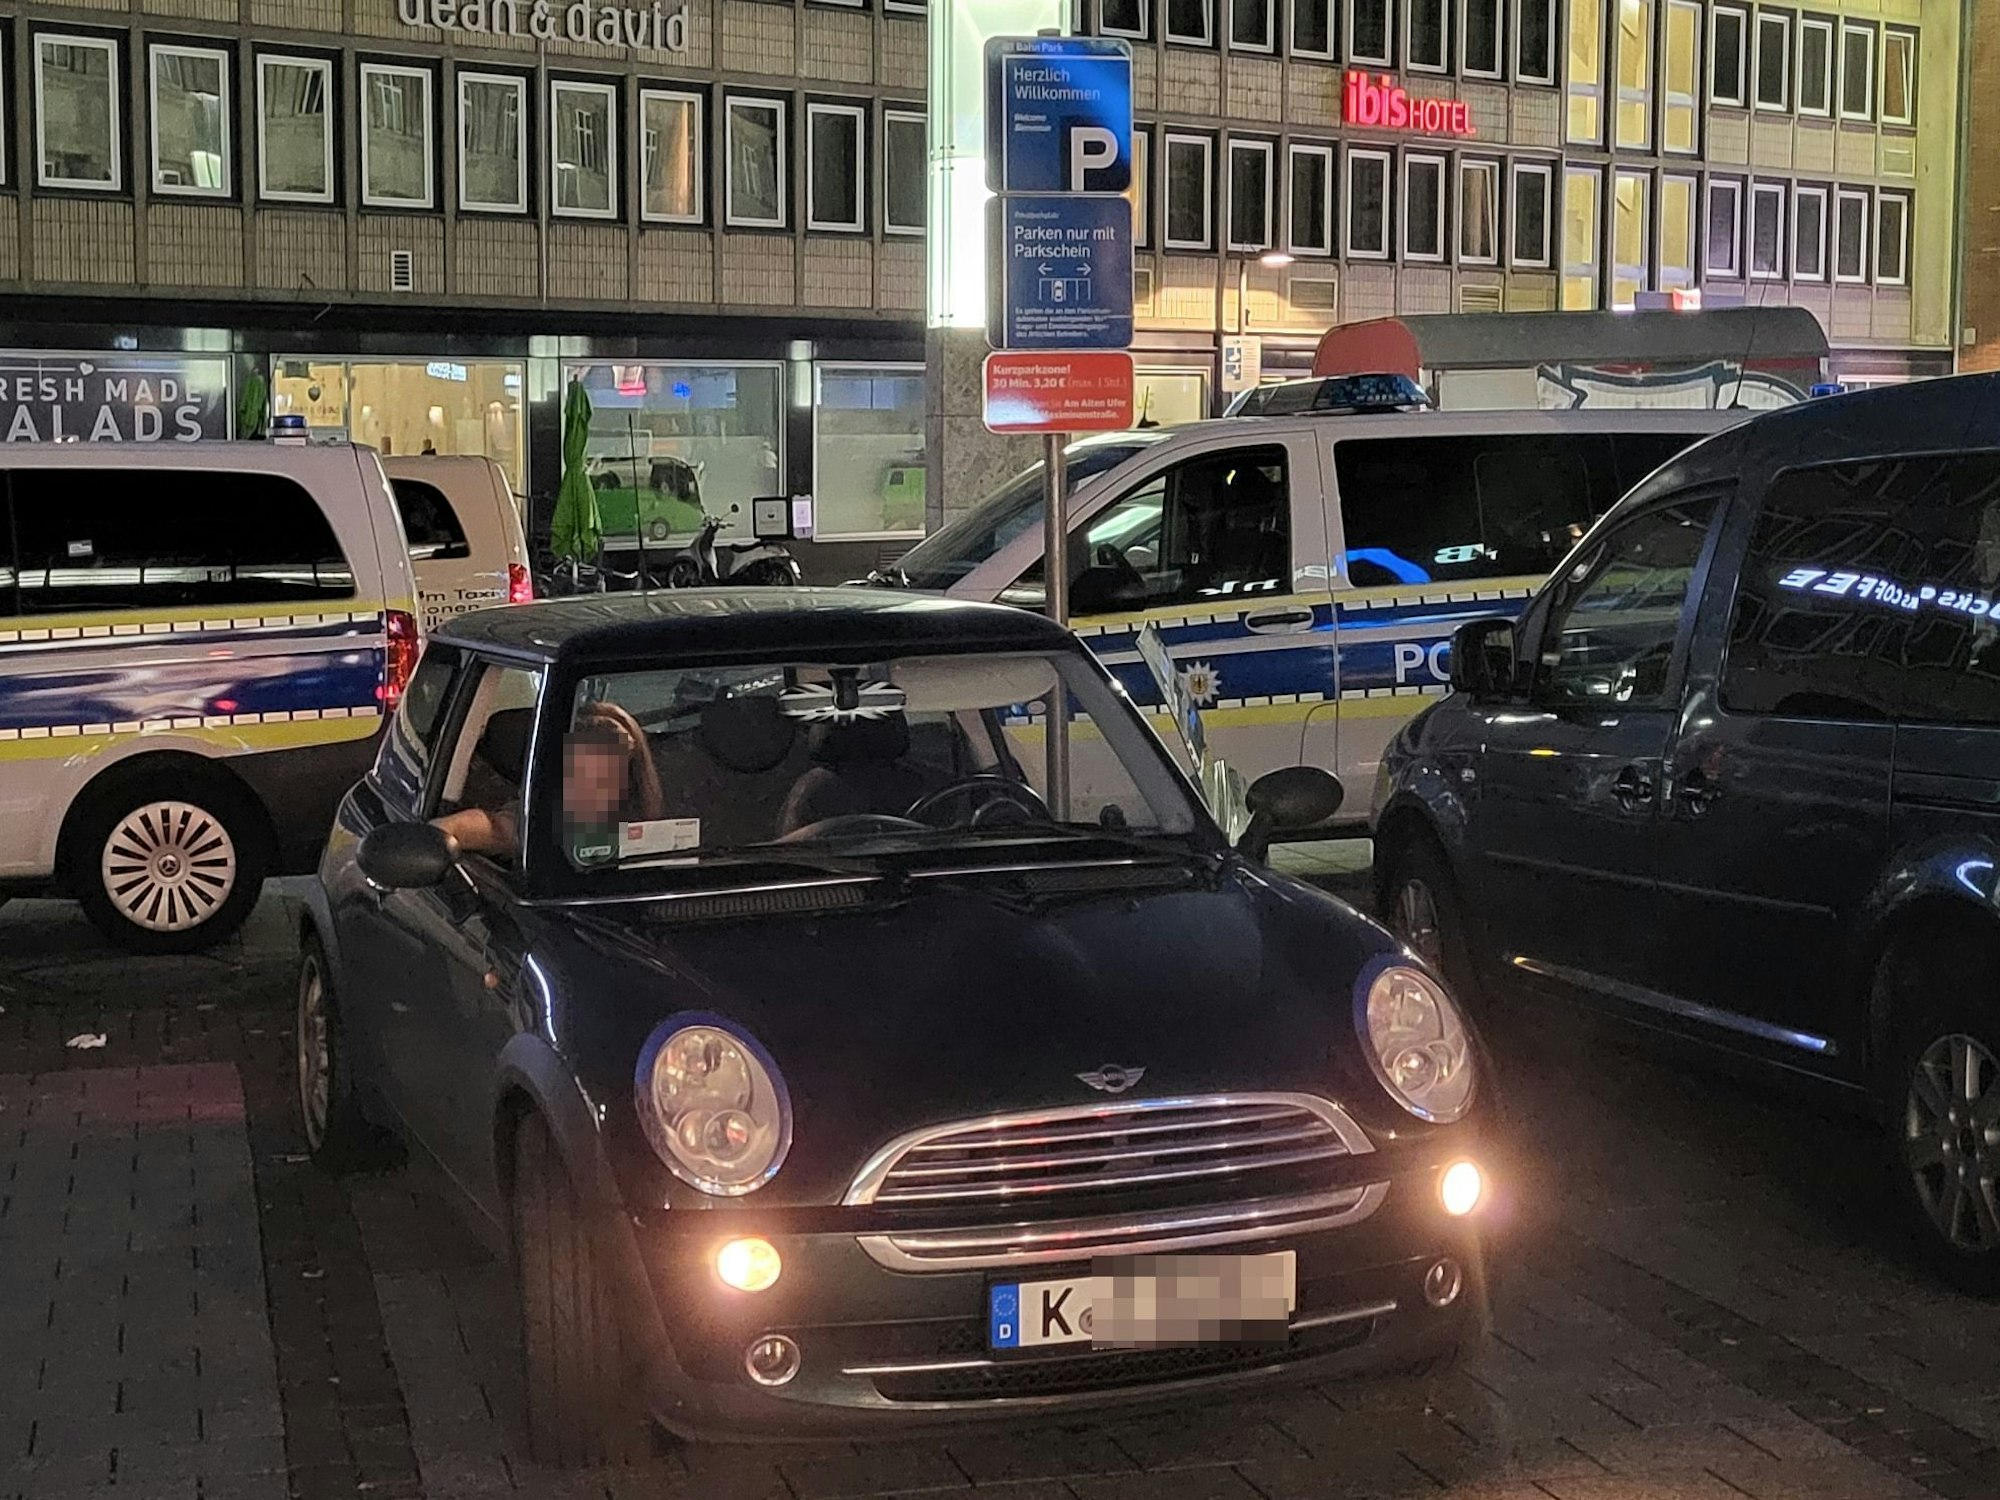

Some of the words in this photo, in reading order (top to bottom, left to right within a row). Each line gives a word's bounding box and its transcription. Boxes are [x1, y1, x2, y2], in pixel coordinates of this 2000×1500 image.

[399, 0, 518, 35] dean
[529, 0, 556, 39] &
[566, 2, 690, 53] david
[1013, 66, 1070, 82] Herzlich
[1014, 84, 1100, 101] Willkommen
[1345, 69, 1407, 127] ibis
[1409, 97, 1476, 134] HOTEL
[1070, 126, 1119, 192] P
[1014, 225, 1063, 240] Parken
[1066, 227, 1090, 240] nur
[1093, 225, 1116, 240] mit
[1014, 243, 1091, 258] Parkschein
[992, 364, 1071, 376] Kurzparkzone!
[105, 378, 202, 403] MADE
[992, 378, 1007, 388] 30
[1009, 378, 1032, 388] Min.
[1033, 378, 1057, 389] 3,20
[1058, 378, 1066, 388] €
[454, 589, 495, 600] Taxi
[1042, 1287, 1074, 1338] K
[999, 1323, 1012, 1340] D
